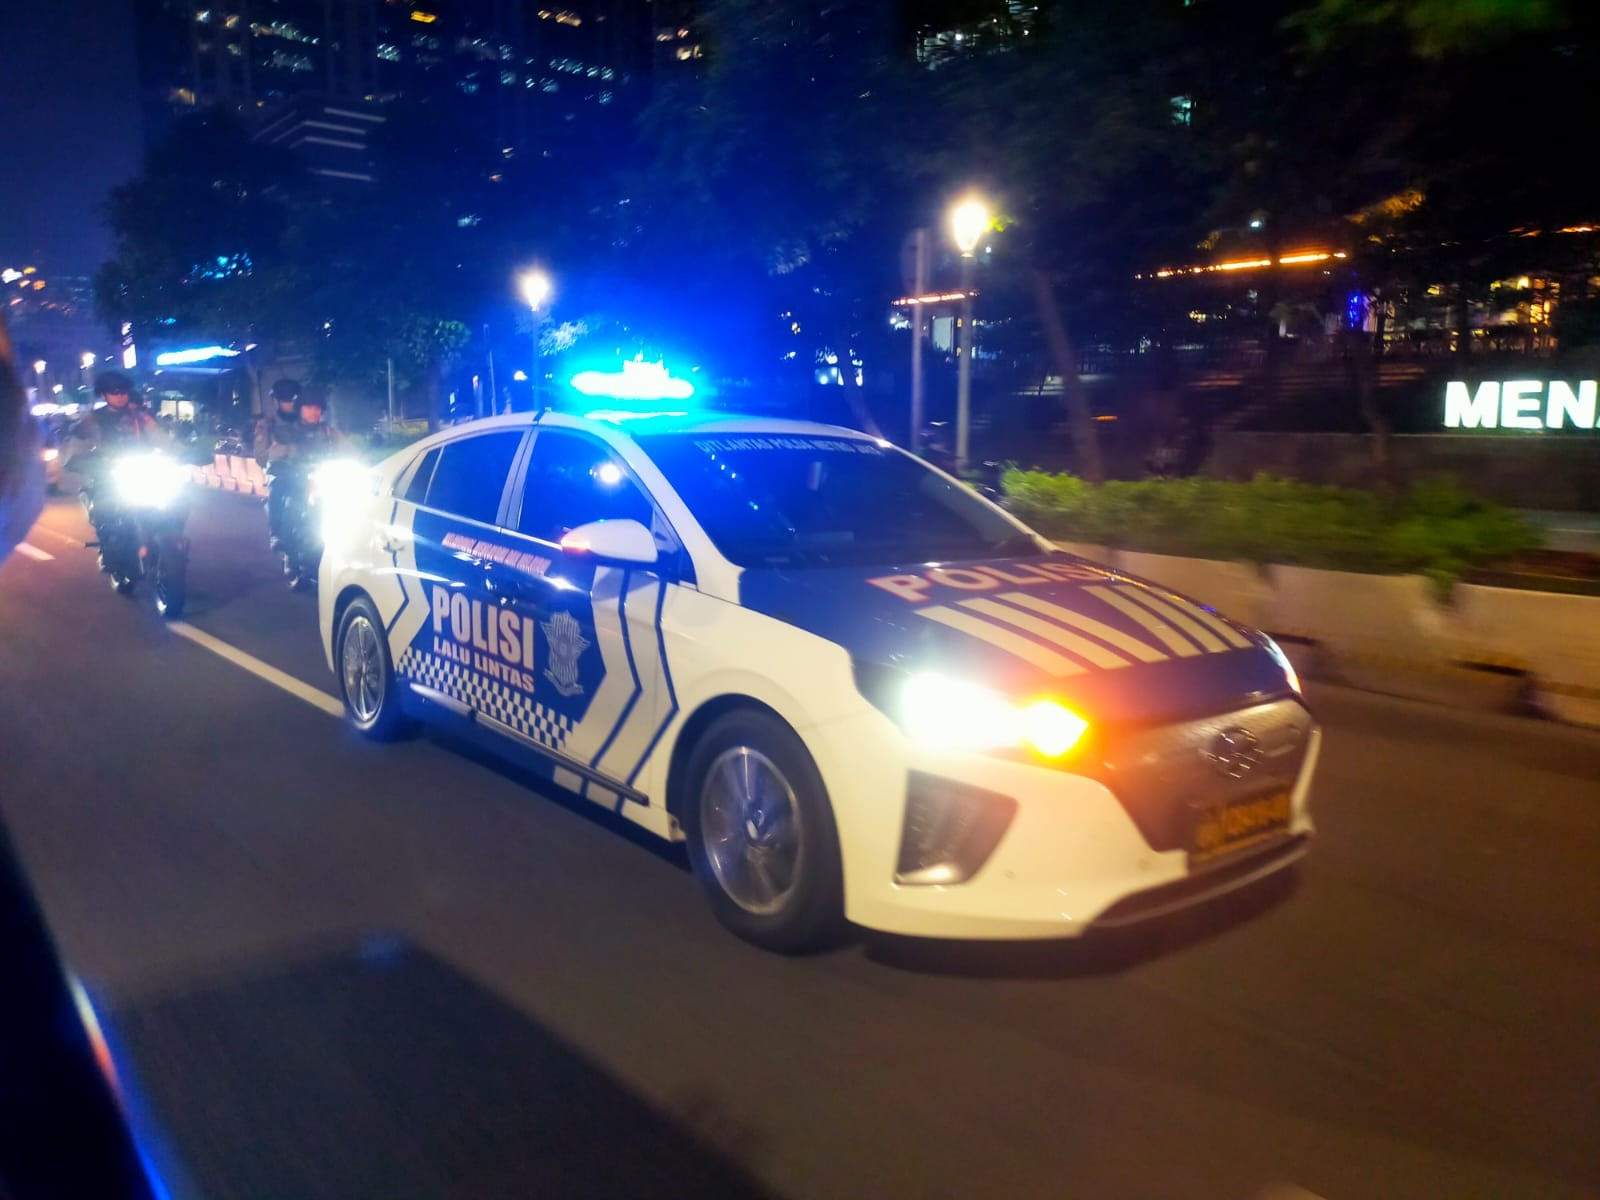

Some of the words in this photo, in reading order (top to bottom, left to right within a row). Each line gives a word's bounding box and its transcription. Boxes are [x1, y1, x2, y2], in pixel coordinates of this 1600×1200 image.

[1443, 380, 1600, 429] MEN
[865, 563, 1105, 602] POLIS
[433, 584, 534, 671] POLISI
[433, 636, 470, 665] LALU
[474, 652, 535, 693] LINTAS
